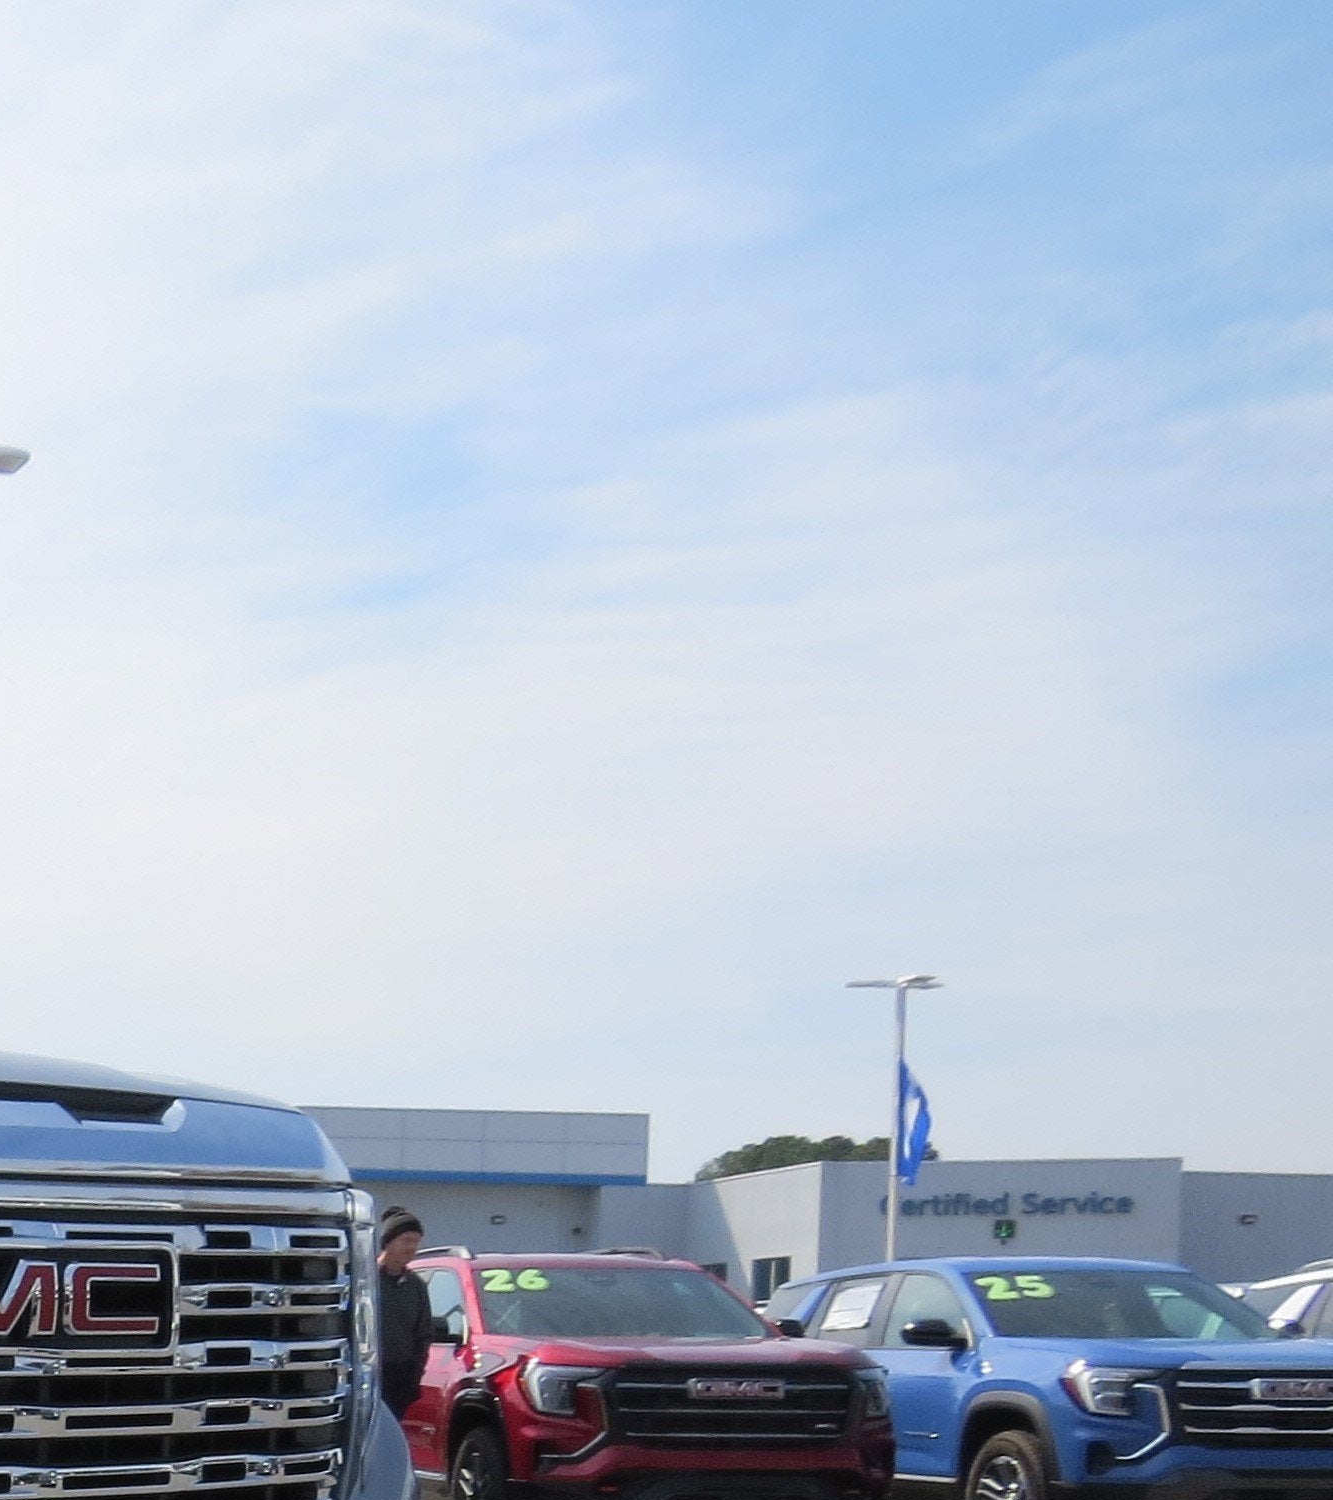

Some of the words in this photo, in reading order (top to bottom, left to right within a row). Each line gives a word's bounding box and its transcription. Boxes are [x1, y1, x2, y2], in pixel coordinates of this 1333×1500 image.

[1021, 1191, 1132, 1215] Service
[481, 1268, 551, 1292] 26
[974, 1274, 1055, 1299] 25
